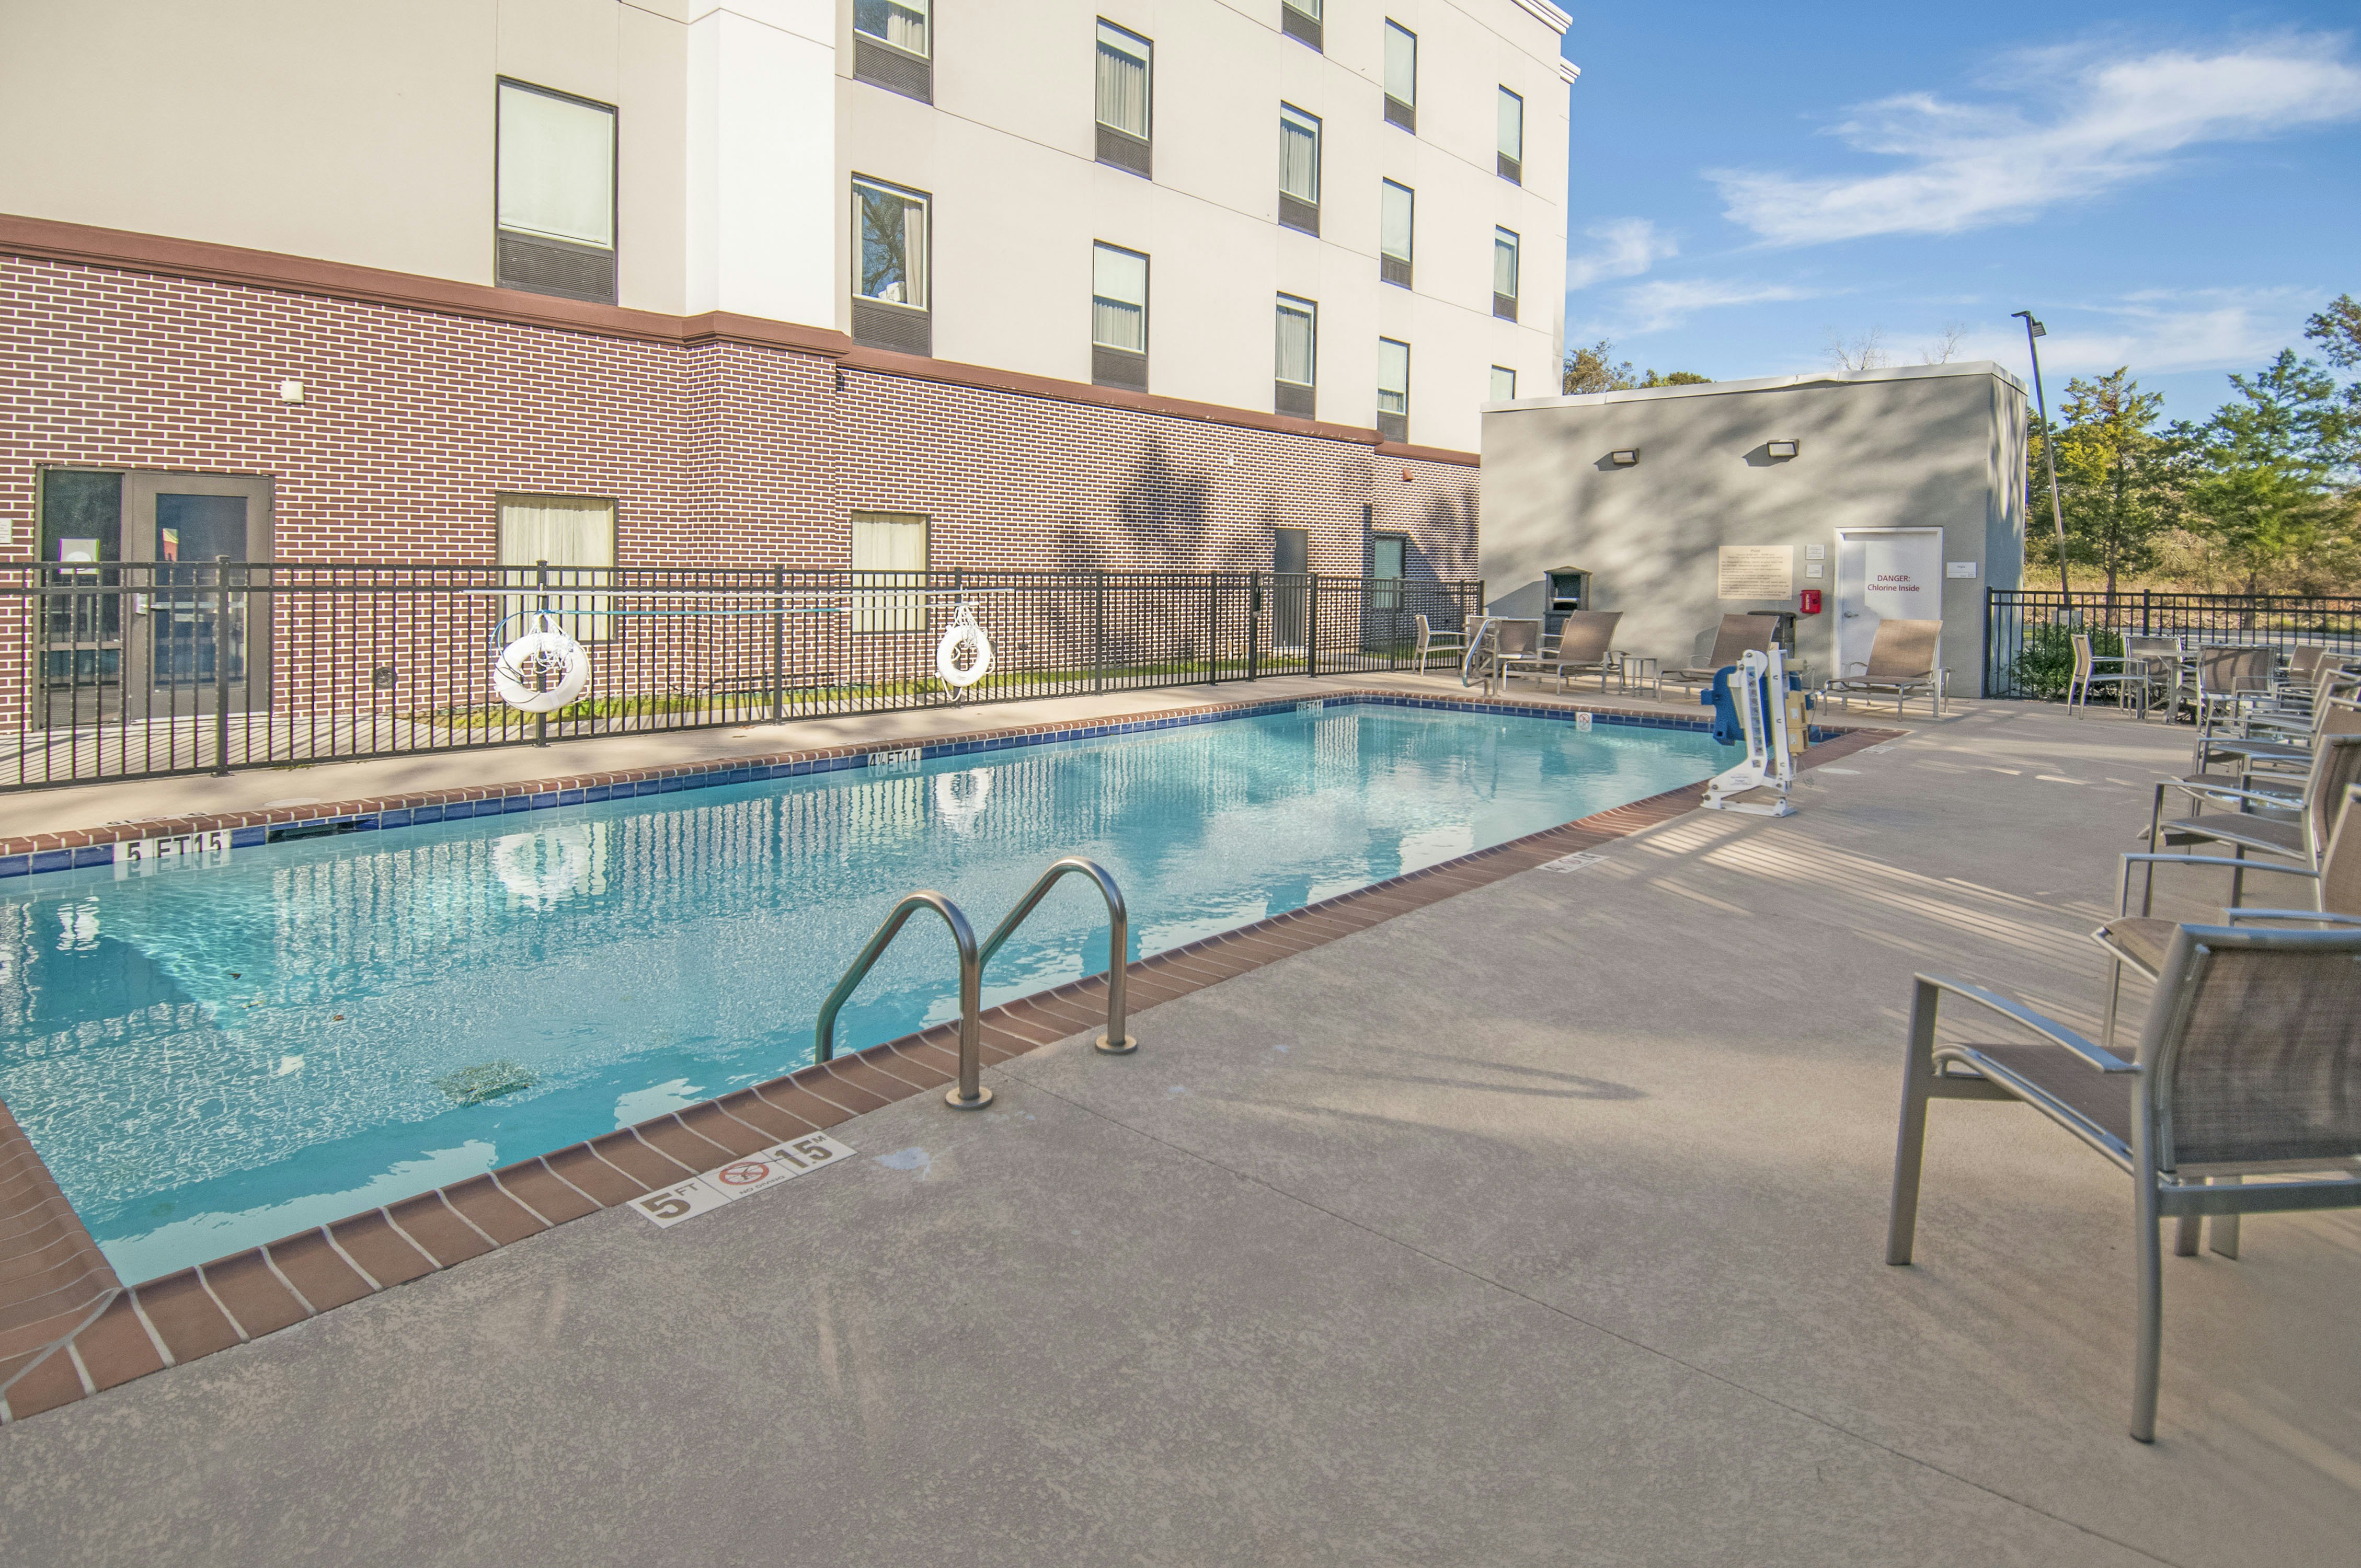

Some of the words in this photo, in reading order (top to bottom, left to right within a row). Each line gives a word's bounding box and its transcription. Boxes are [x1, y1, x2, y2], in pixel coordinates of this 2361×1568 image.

[887, 752, 902, 764] FT
[127, 841, 141, 861] 5
[157, 836, 190, 858] FT
[755, 1176, 785, 1188] DIVING
[639, 1192, 691, 1219] 5
[675, 1183, 698, 1196] FT
